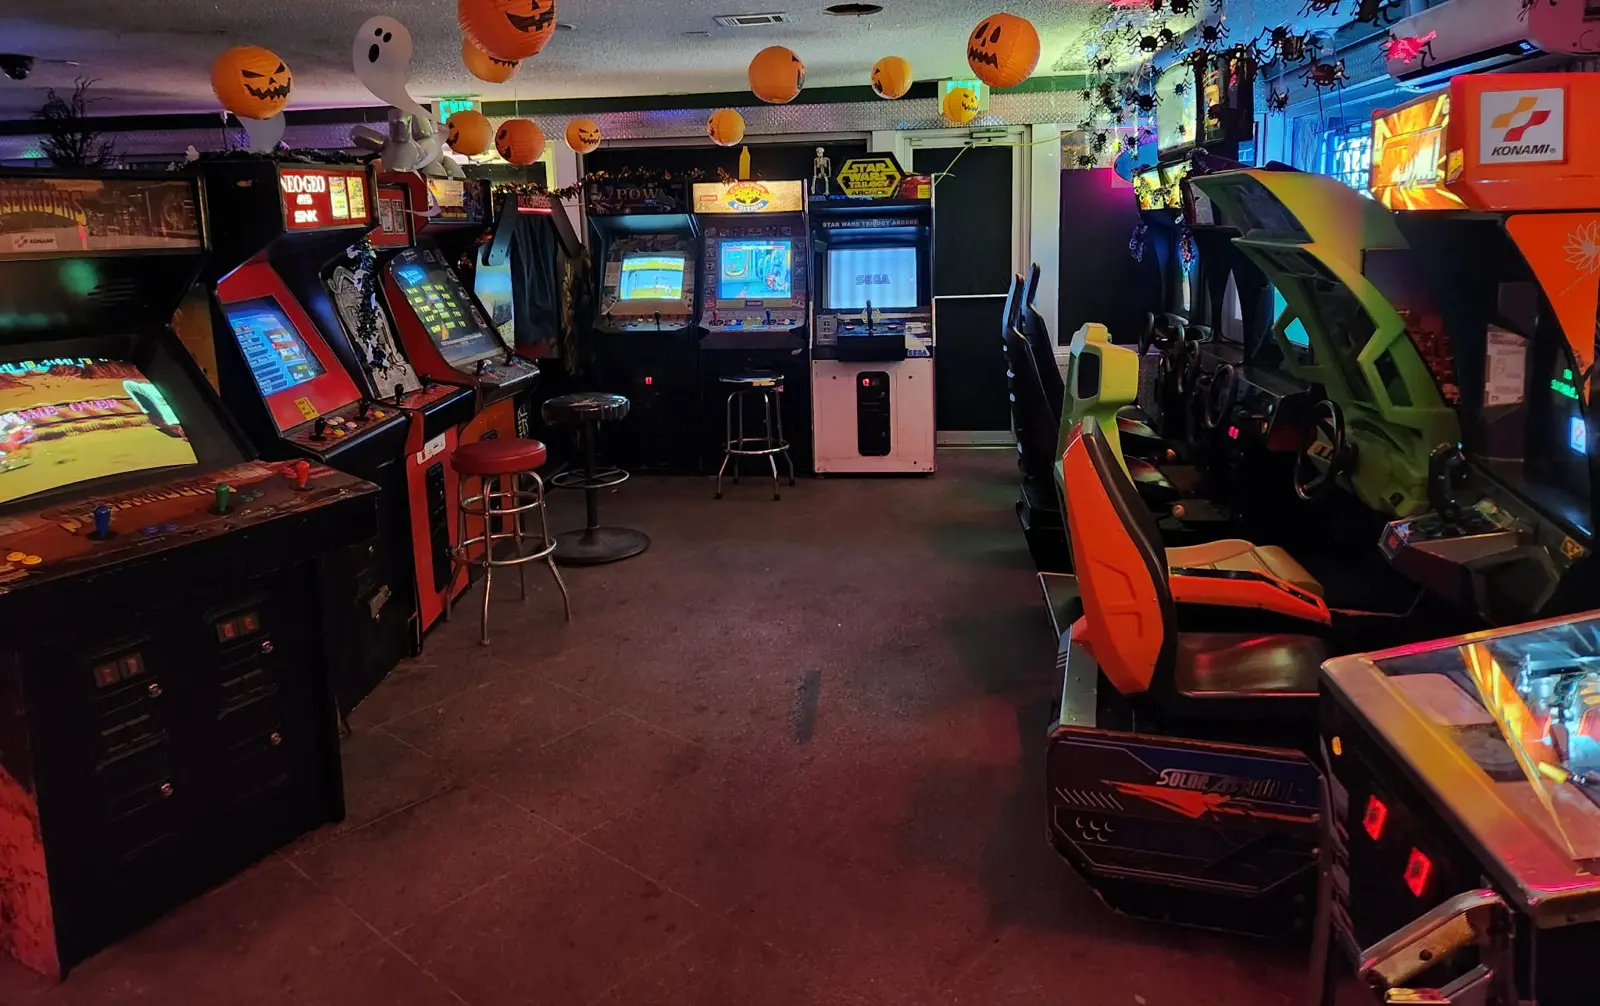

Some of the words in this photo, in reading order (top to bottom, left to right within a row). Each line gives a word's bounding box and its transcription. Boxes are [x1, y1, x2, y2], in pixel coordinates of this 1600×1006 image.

[1491, 145, 1550, 157] KONAMI
[850, 163, 888, 173] STAR
[849, 172, 888, 182] WARS
[848, 181, 890, 189] TRILOGY
[733, 202, 766, 213] EDITION
[294, 210, 319, 223] SNK
[822, 221, 841, 229] STAR
[841, 220, 861, 228] WARS
[862, 219, 891, 228] TRILOGY
[855, 273, 892, 286] SEGA
[69, 399, 121, 412] OVER
[1156, 767, 1209, 790] SOLAR
